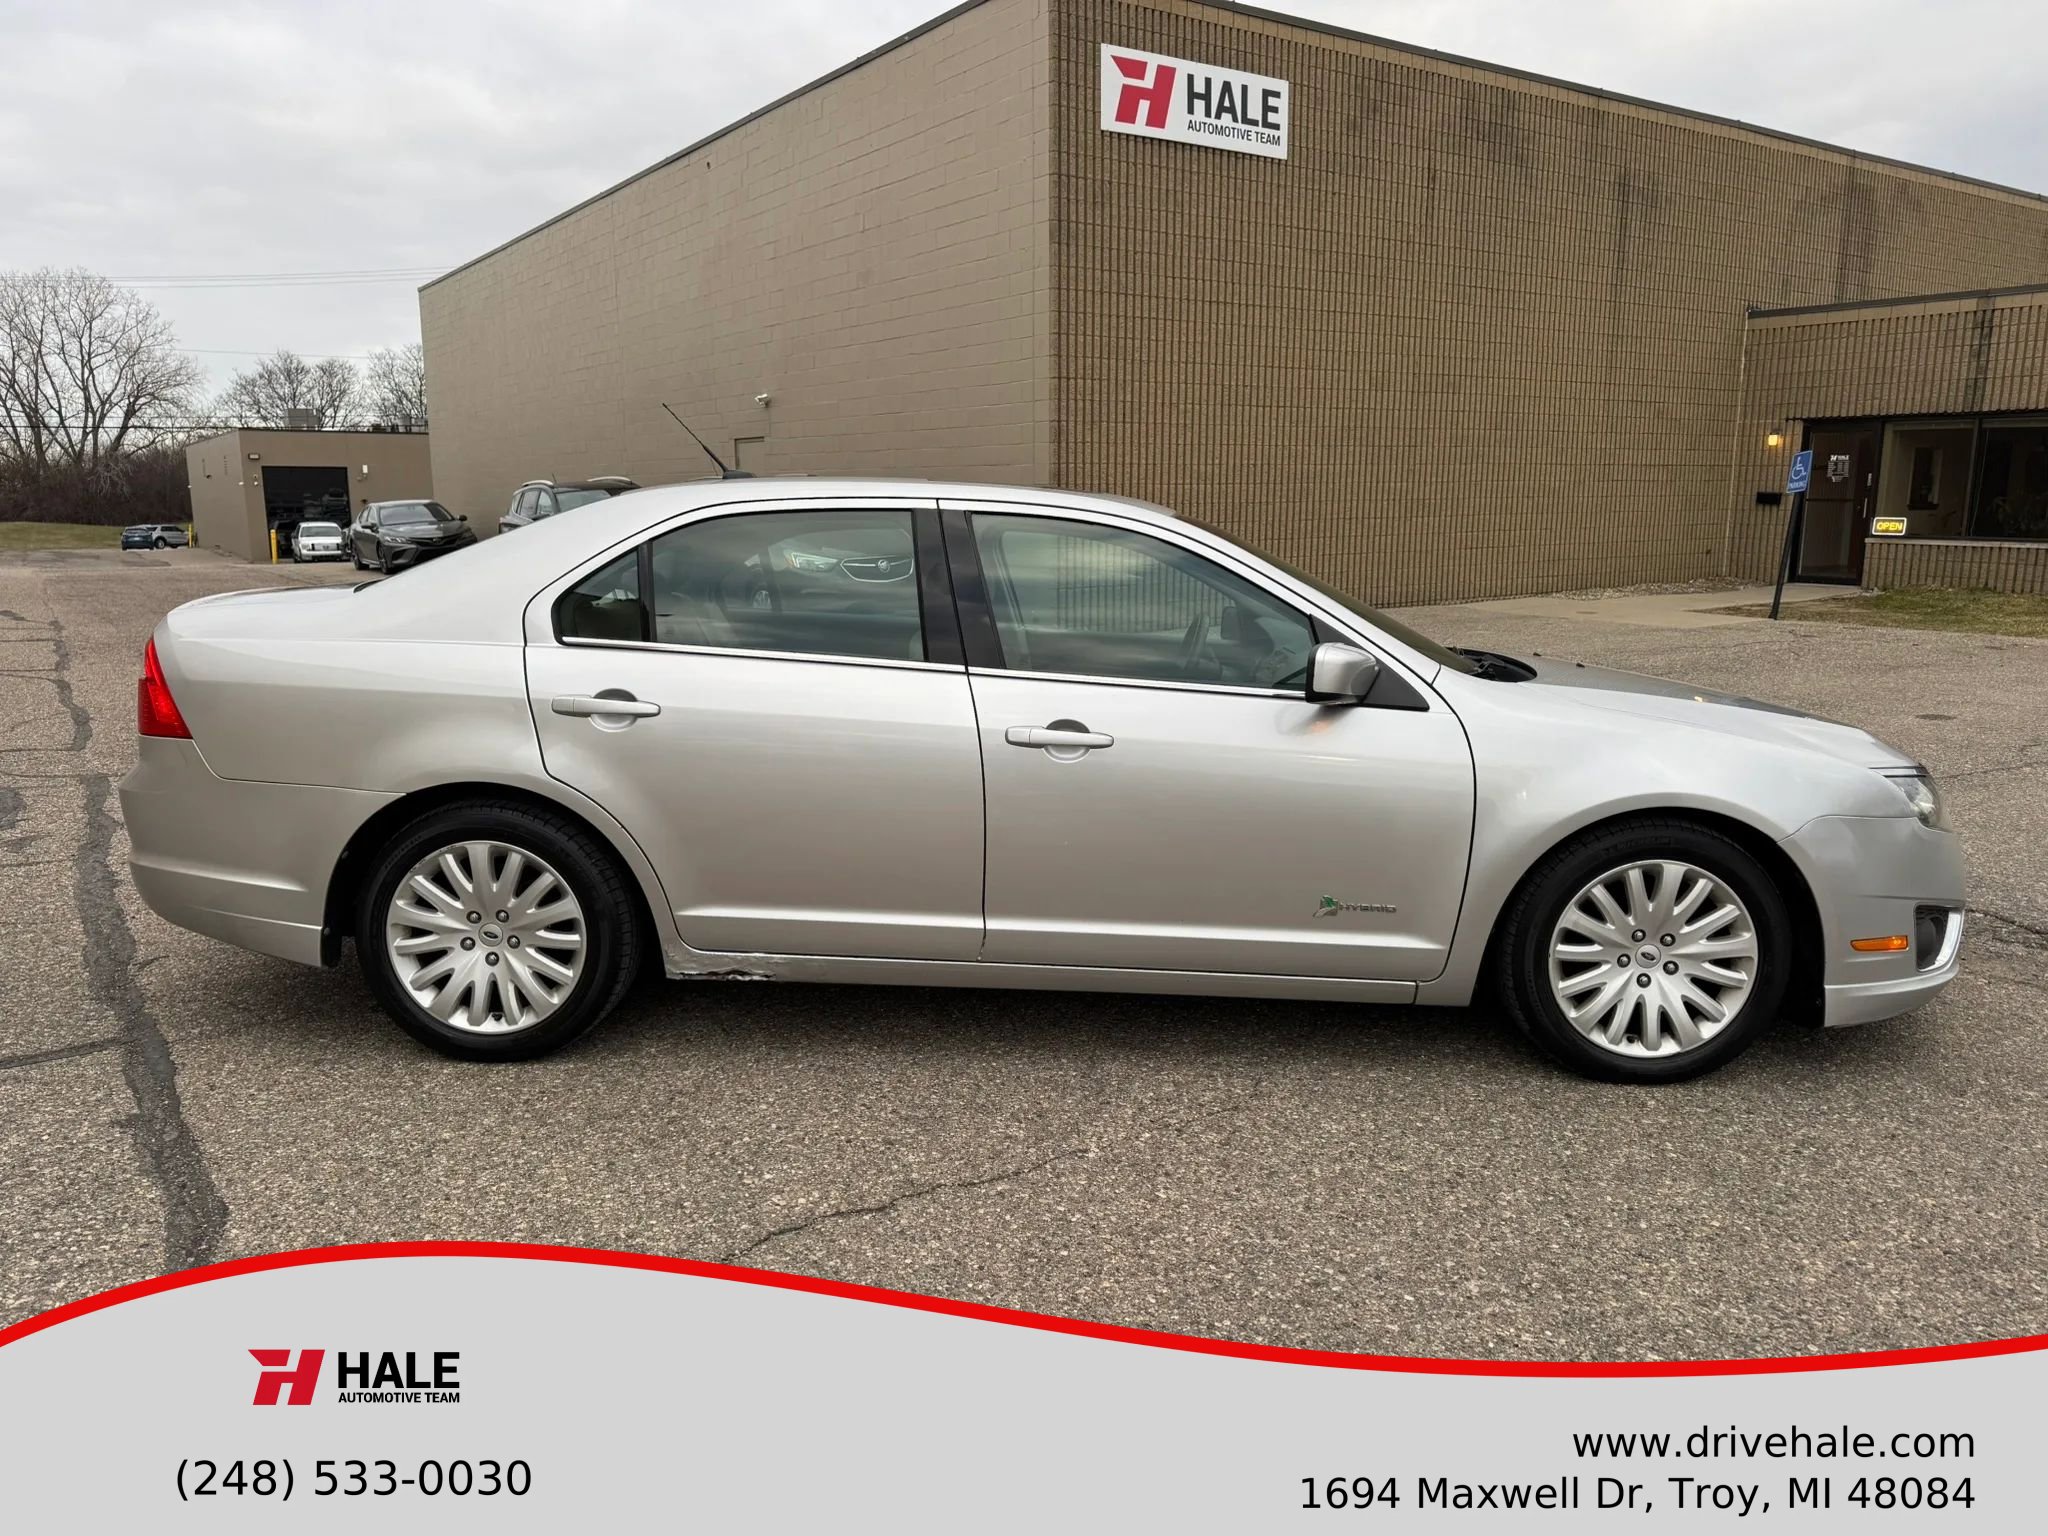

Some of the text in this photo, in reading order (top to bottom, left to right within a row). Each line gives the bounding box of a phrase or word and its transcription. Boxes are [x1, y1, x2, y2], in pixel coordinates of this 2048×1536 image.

[1186, 73, 1281, 131] HALE
[1187, 119, 1281, 146] AUTOMOTIVE TEAM
[1876, 521, 1904, 531] OPEN
[1338, 902, 1397, 914] HYBRID
